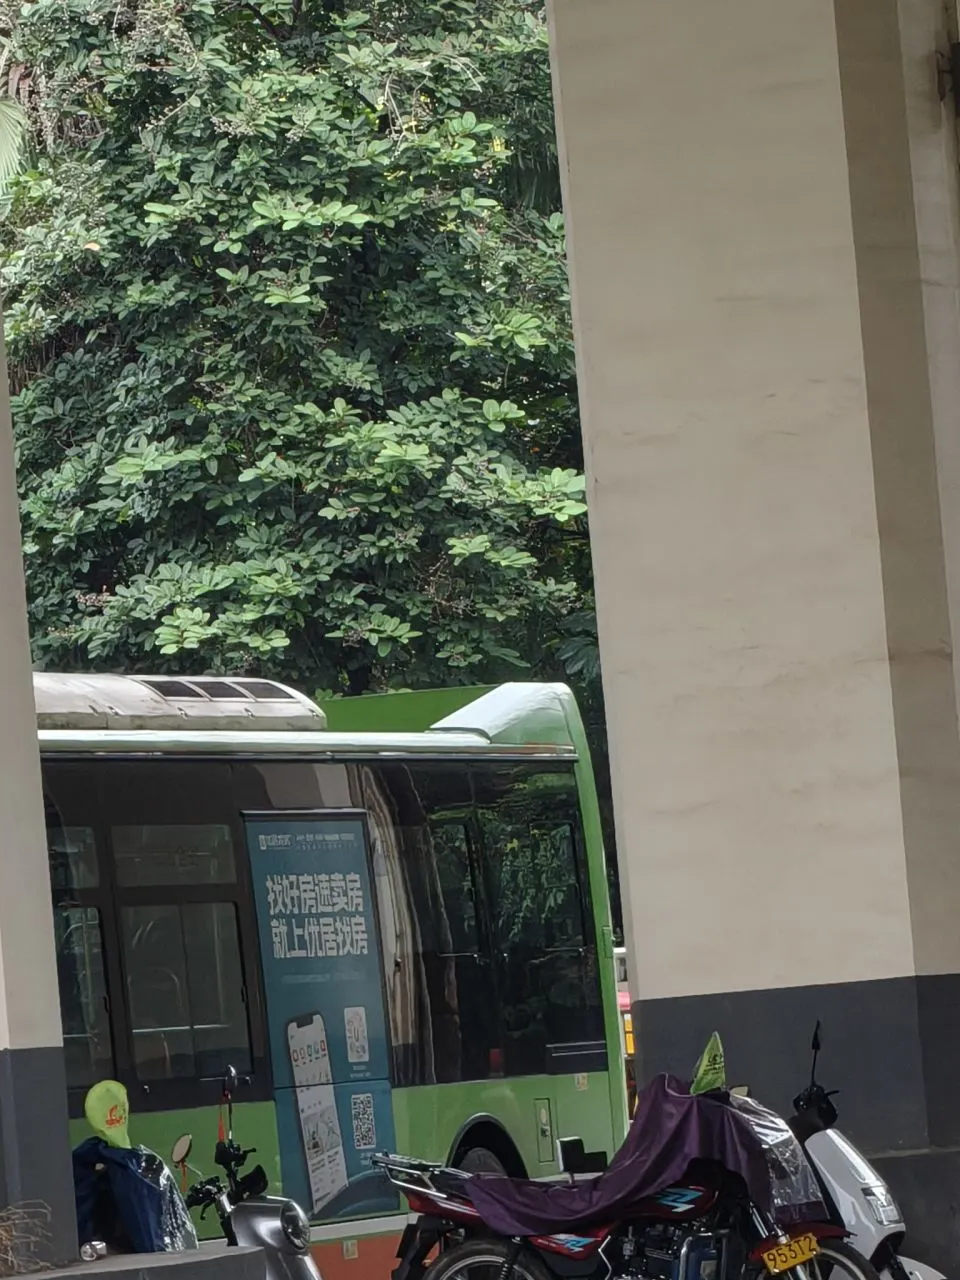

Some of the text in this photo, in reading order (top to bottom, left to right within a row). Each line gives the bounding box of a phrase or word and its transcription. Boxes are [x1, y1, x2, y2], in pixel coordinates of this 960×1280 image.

[266, 872, 364, 915] 找好房速卖房
[270, 915, 368, 959] 就上优居找房
[766, 1235, 817, 1270] 953T2
